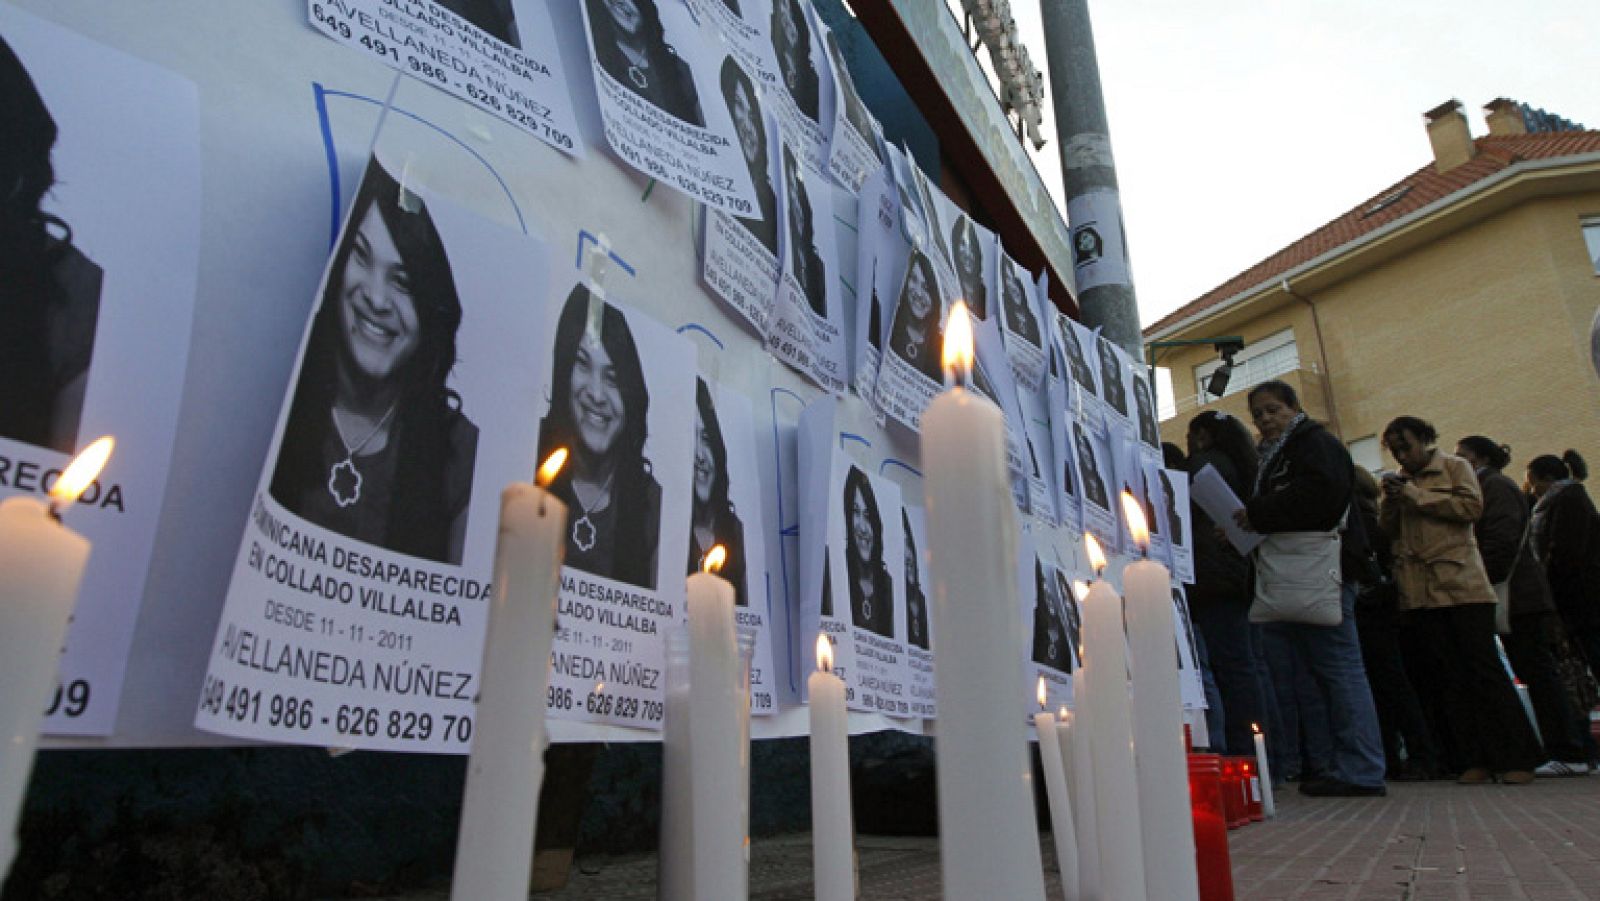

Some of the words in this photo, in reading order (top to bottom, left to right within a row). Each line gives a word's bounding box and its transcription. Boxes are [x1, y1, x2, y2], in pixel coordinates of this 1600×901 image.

[312, 3, 352, 39] 649
[360, 34, 399, 62] 491
[407, 55, 448, 84] 986
[466, 82, 501, 112] 626
[505, 103, 538, 130] 829
[541, 121, 574, 149] 709
[457, 32, 533, 81] VILLALBA
[726, 195, 753, 214] 709
[0, 456, 125, 513] RECDA
[265, 554, 354, 604] COLLADO
[359, 585, 462, 626] VILLALBA
[332, 547, 493, 601] DESAPARECIDA
[578, 580, 674, 618] DESAPARECIDA
[265, 600, 316, 632] DESDE
[320, 617, 334, 635] 11
[350, 624, 363, 643] 11
[377, 629, 413, 651] 2011
[573, 631, 583, 647] 11
[592, 635, 604, 649] 11
[611, 637, 633, 653] 2011
[597, 608, 658, 634] VILLALBA
[220, 622, 366, 689] AVELLANEDA
[373, 660, 473, 701] NÚÑEZ
[609, 660, 661, 691] NÚÑEZ
[225, 685, 263, 723] 491
[269, 694, 314, 730] 986
[336, 704, 380, 736] 626
[386, 709, 433, 740] 829
[586, 691, 614, 716] 626
[614, 695, 639, 718] 829
[641, 699, 664, 722] 709
